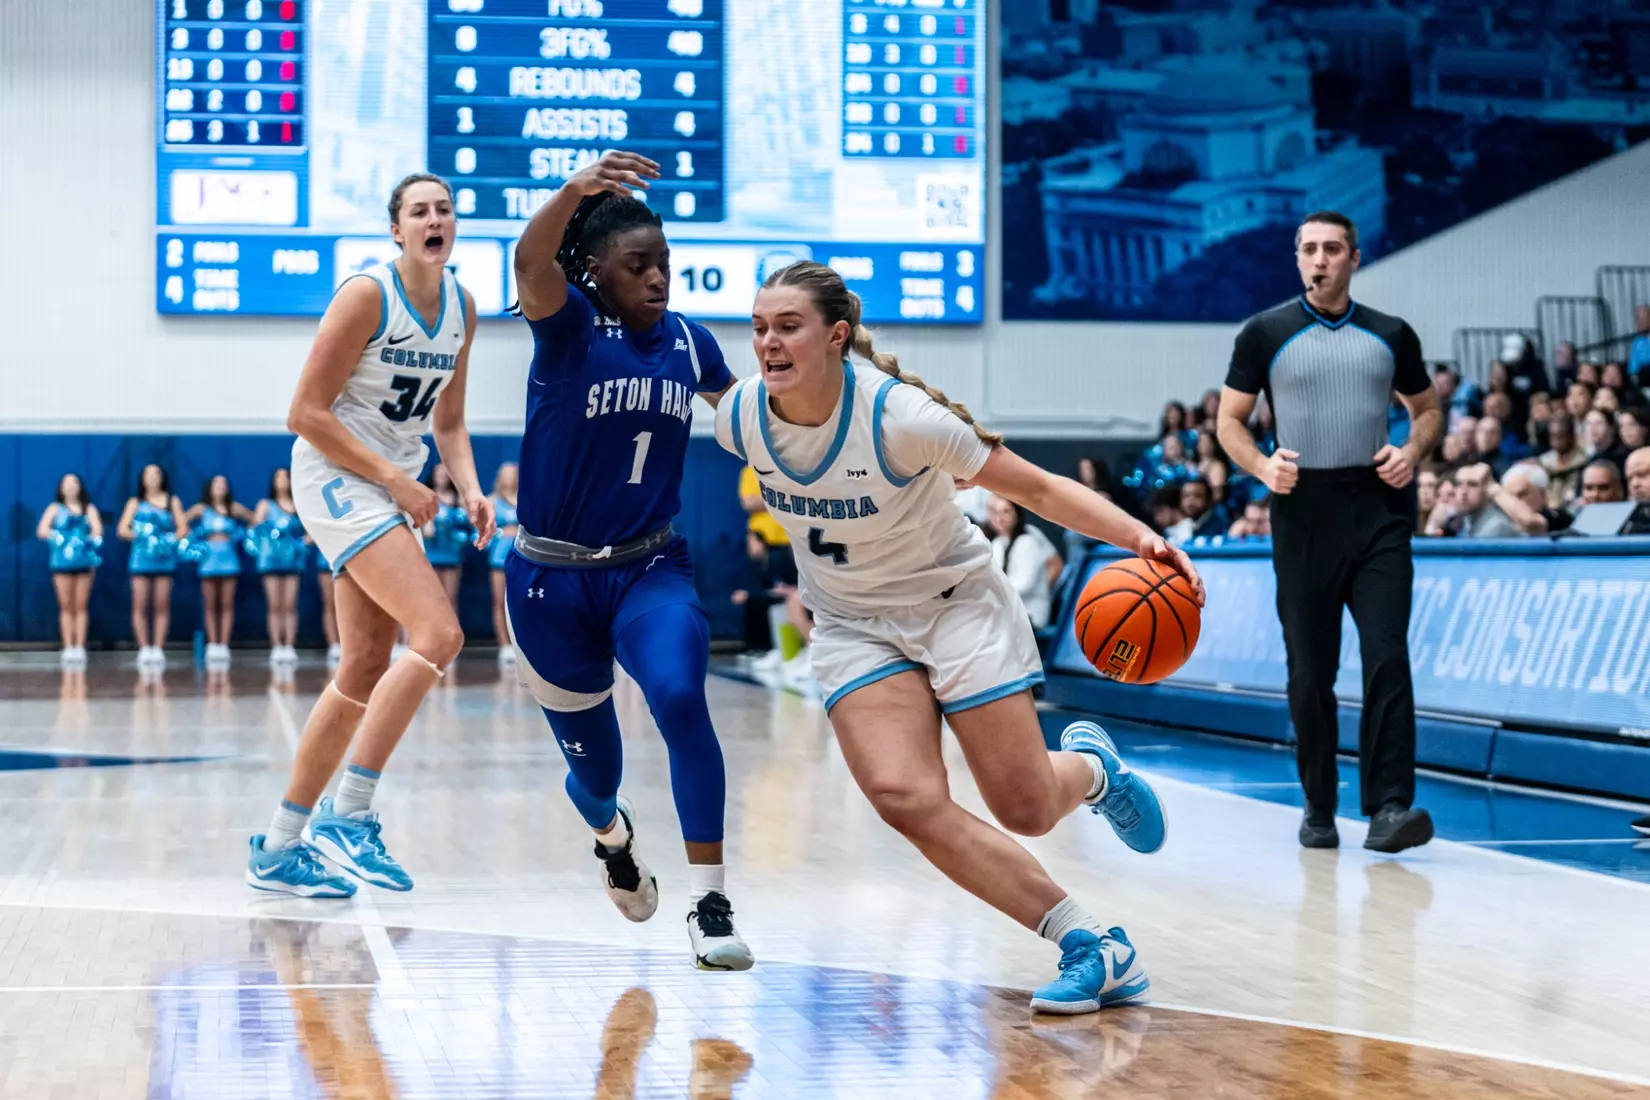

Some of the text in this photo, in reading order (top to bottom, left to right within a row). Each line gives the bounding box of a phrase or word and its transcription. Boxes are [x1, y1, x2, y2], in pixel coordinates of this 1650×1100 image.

[540, 27, 611, 59] 3FG%
[510, 66, 642, 100] REBOUNDS
[457, 107, 475, 133] 1
[522, 108, 628, 141] ASSISTS
[676, 151, 695, 177] 1
[680, 267, 723, 293] 10
[379, 374, 443, 423] 34
[585, 376, 653, 420] SETON
[626, 430, 653, 485] 1
[320, 476, 354, 520] C
[808, 526, 848, 566] 4
